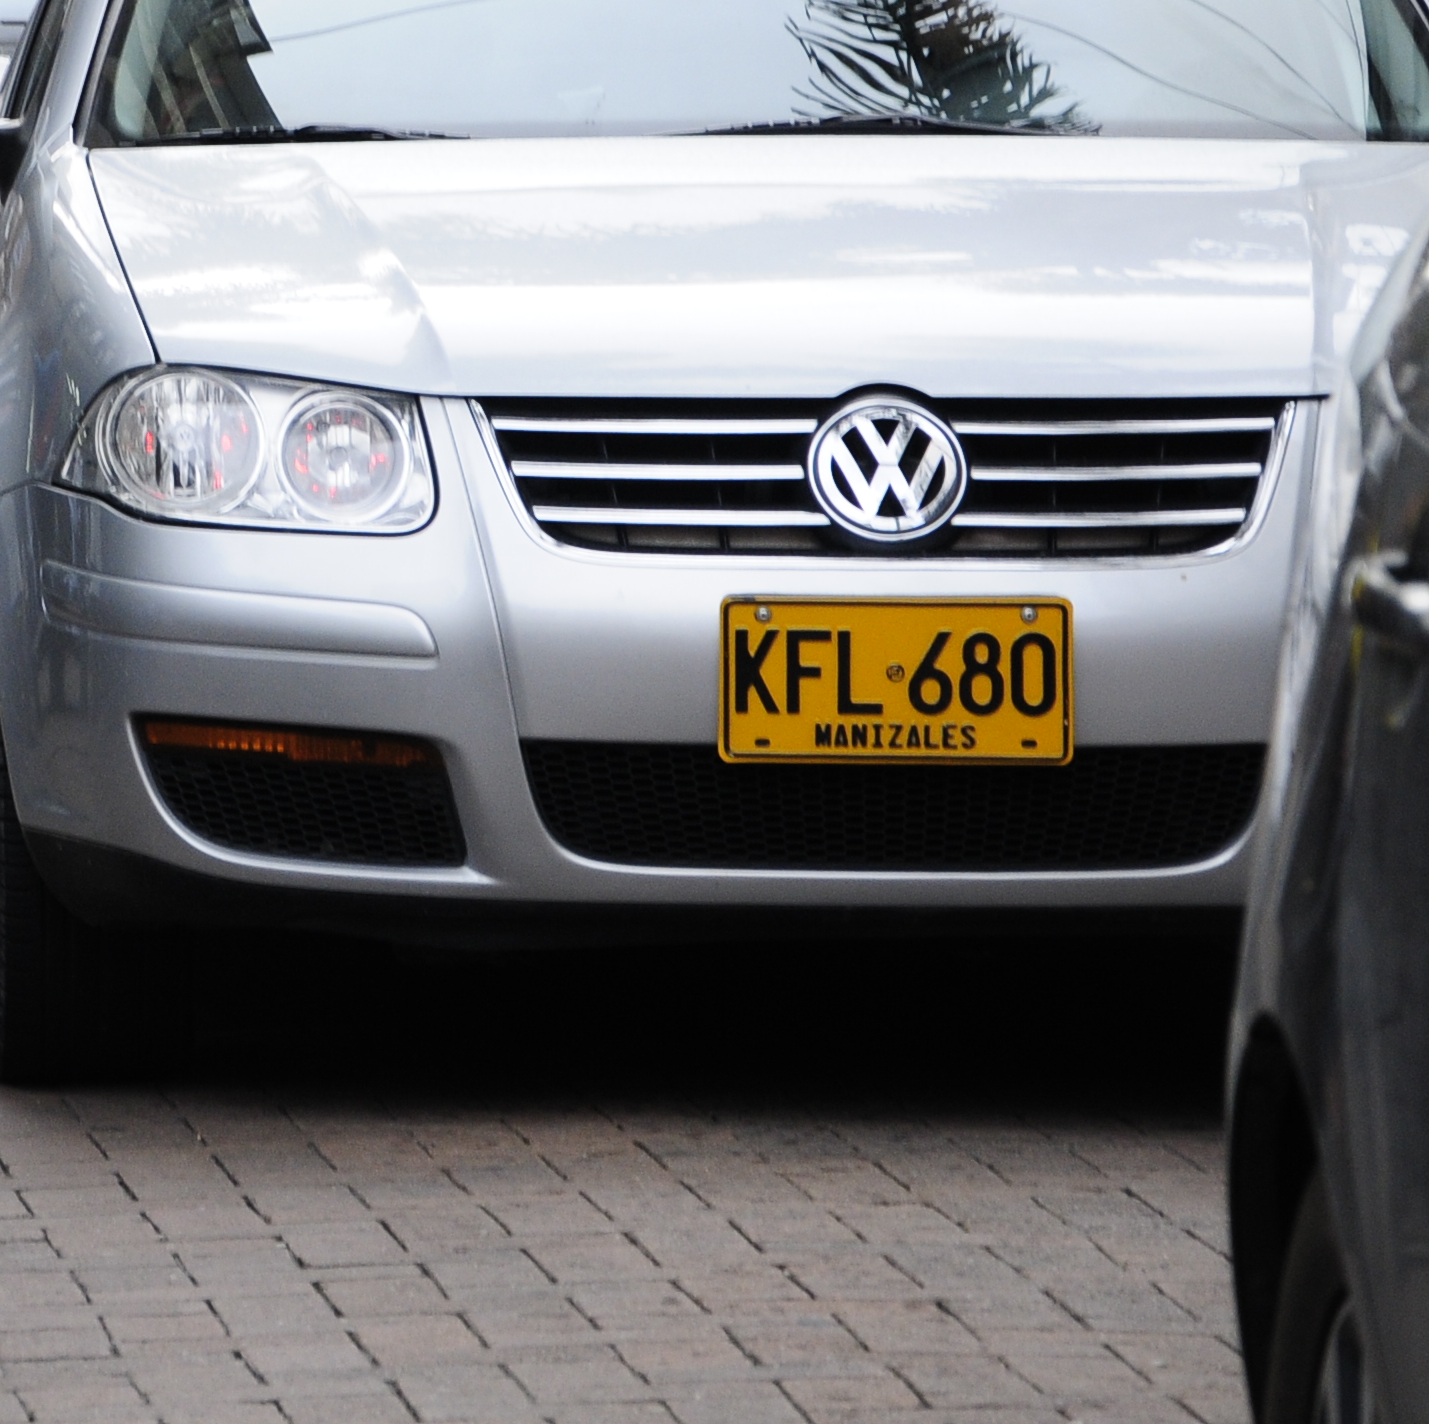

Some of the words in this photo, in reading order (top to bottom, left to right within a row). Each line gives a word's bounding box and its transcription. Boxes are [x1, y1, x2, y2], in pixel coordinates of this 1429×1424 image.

[734, 628, 884, 716] KFL
[907, 630, 1057, 717] 680
[815, 723, 977, 751] MANIZALES
